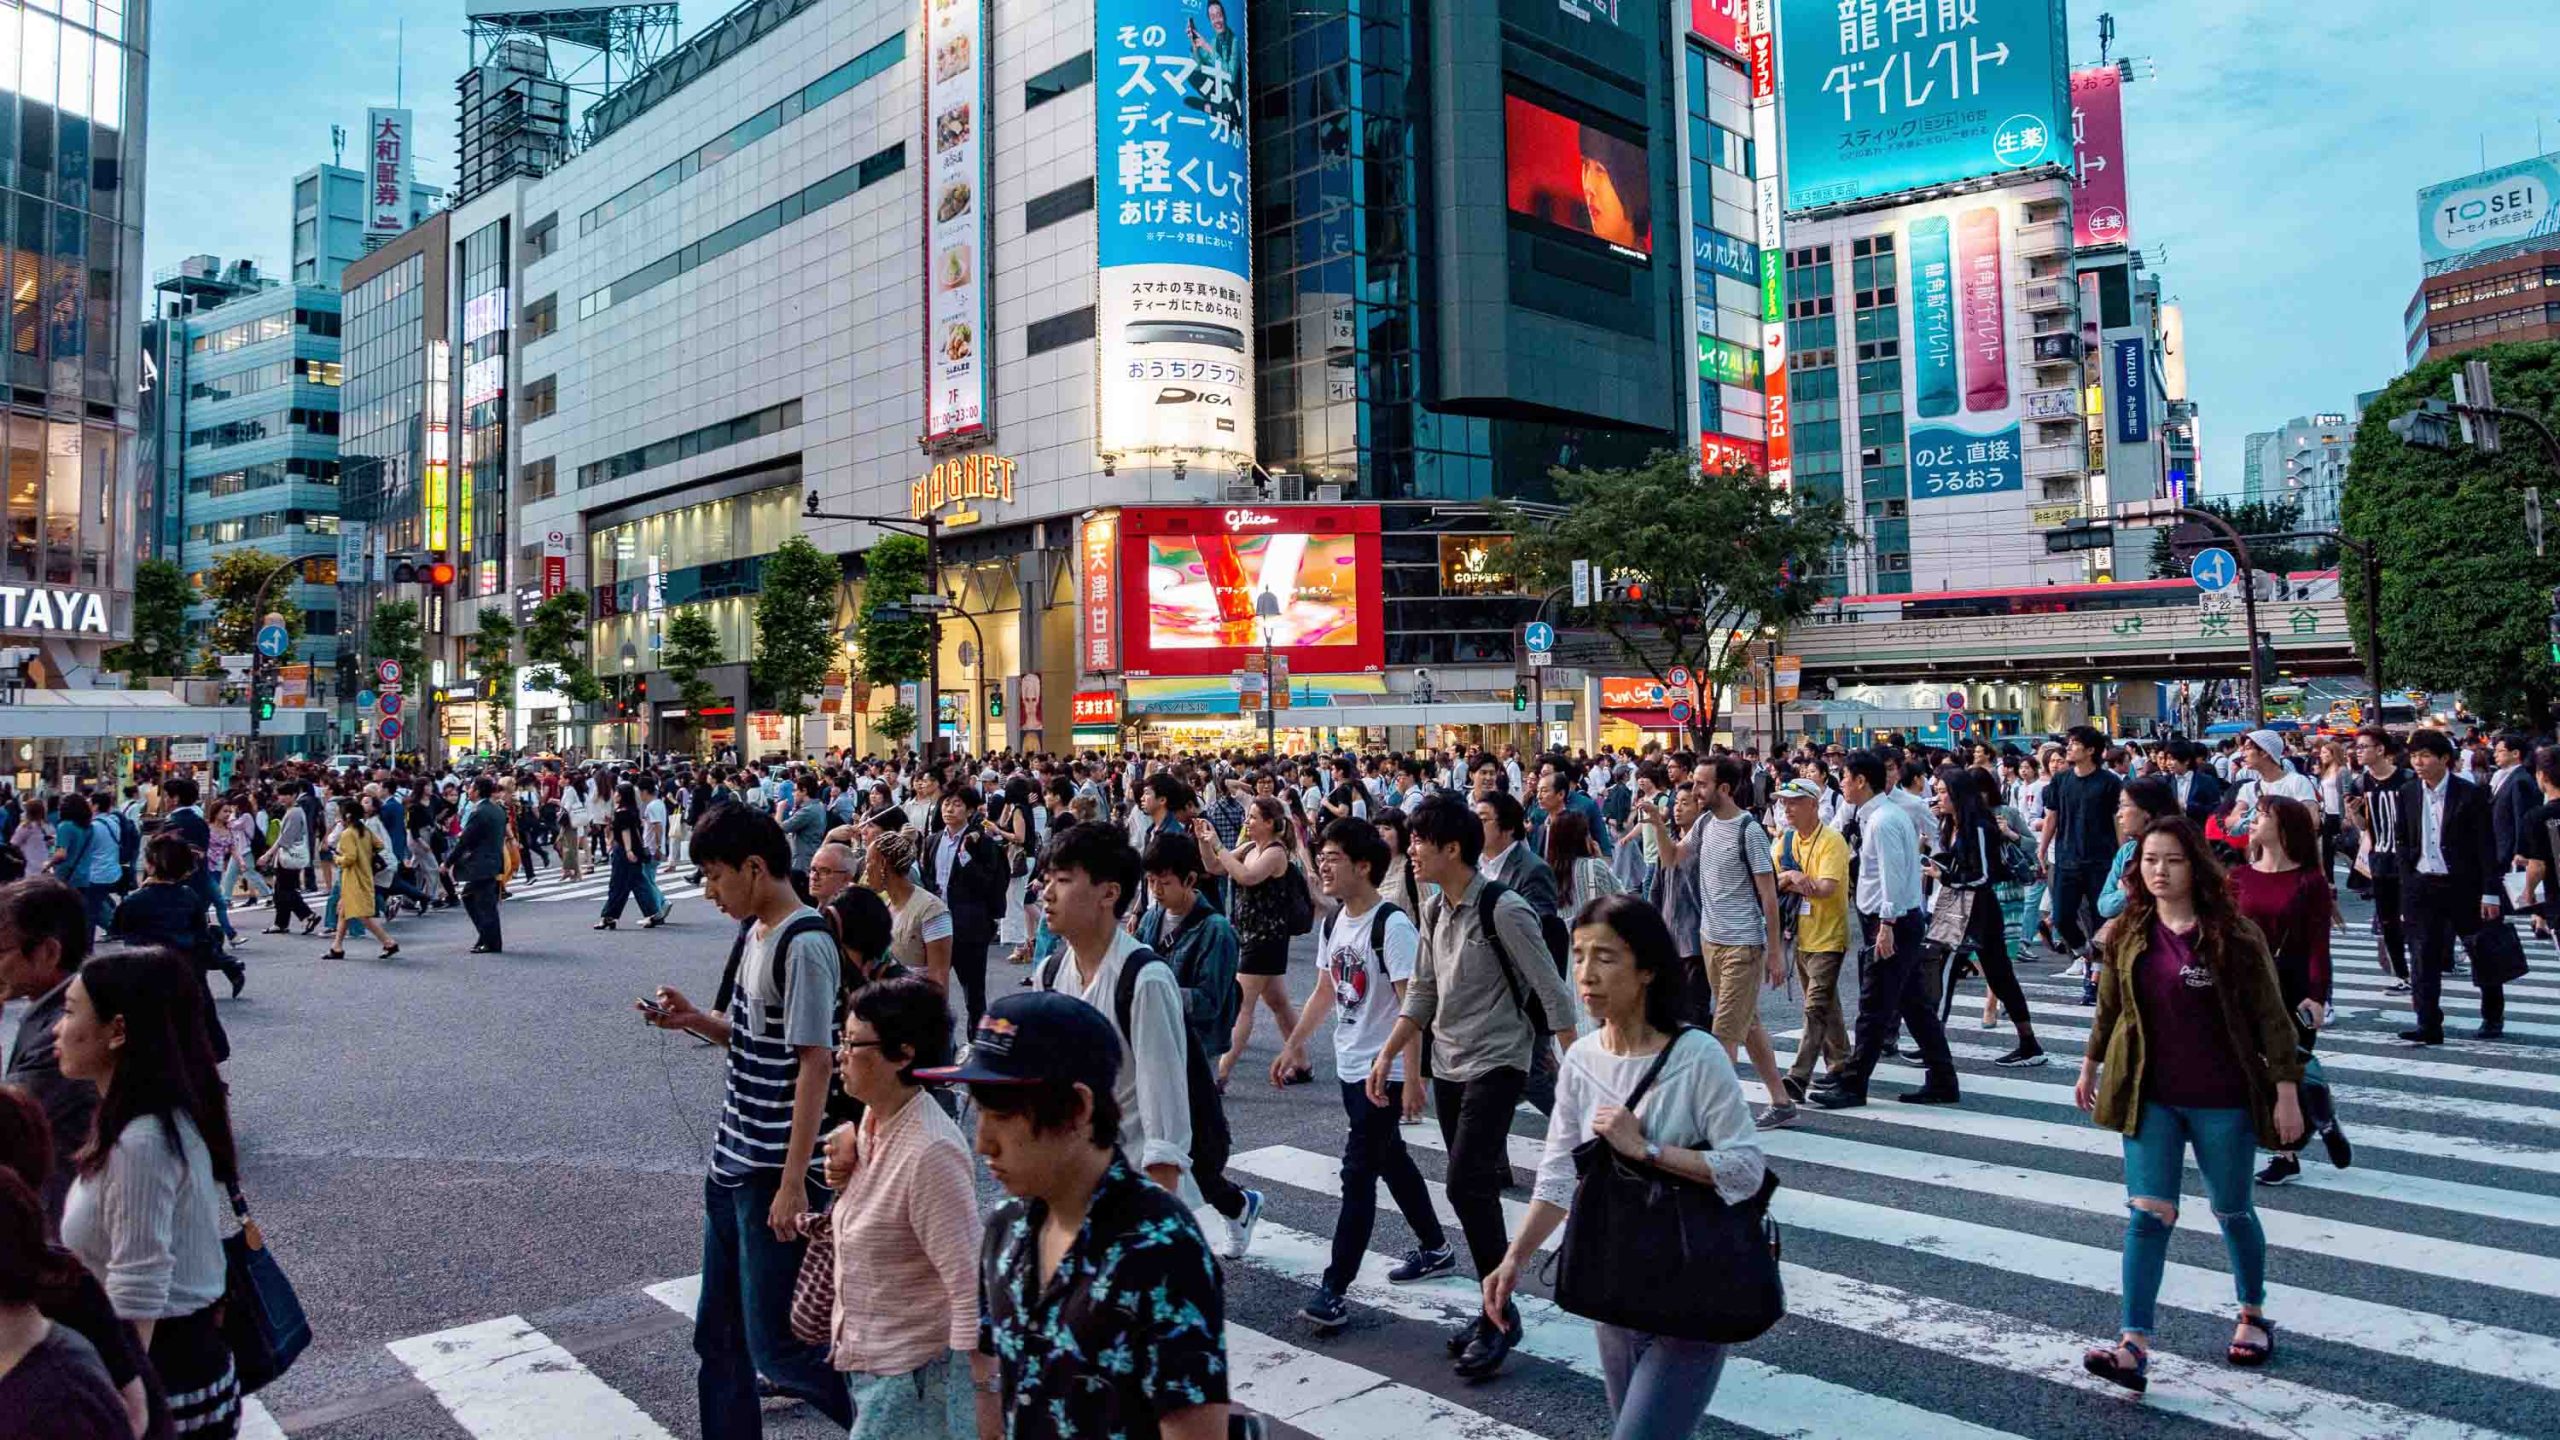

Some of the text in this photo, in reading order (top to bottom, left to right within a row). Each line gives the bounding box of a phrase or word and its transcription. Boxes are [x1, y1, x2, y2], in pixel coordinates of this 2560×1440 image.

[1116, 25, 1167, 49] その
[1756, 50, 1771, 97] アイフル
[1821, 36, 2010, 122] ダイレクト
[1117, 101, 1243, 149] ディーガが
[1838, 119, 1917, 150] スティック
[1997, 128, 2045, 156] 生薬
[1117, 139, 1244, 206] 軽くして
[2444, 187, 2533, 224] TOSEI
[2090, 214, 2122, 232] 生薬
[2125, 346, 2138, 388] MIZUHO
[948, 388, 960, 406] 7F
[1155, 387, 1233, 407] DIGA
[1769, 395, 1786, 438] アコム
[1916, 439, 2020, 468] のど、直接、
[910, 454, 1017, 521] MAGNET
[1926, 467, 2005, 494] うるおう
[1225, 510, 1280, 532] Glico
[2095, 508, 2107, 518] 3F
[1090, 545, 1110, 666] 天津甘栗
[2113, 616, 2143, 634] JR
[1169, 727, 1192, 737] TAX
[1196, 727, 1222, 737] Free
